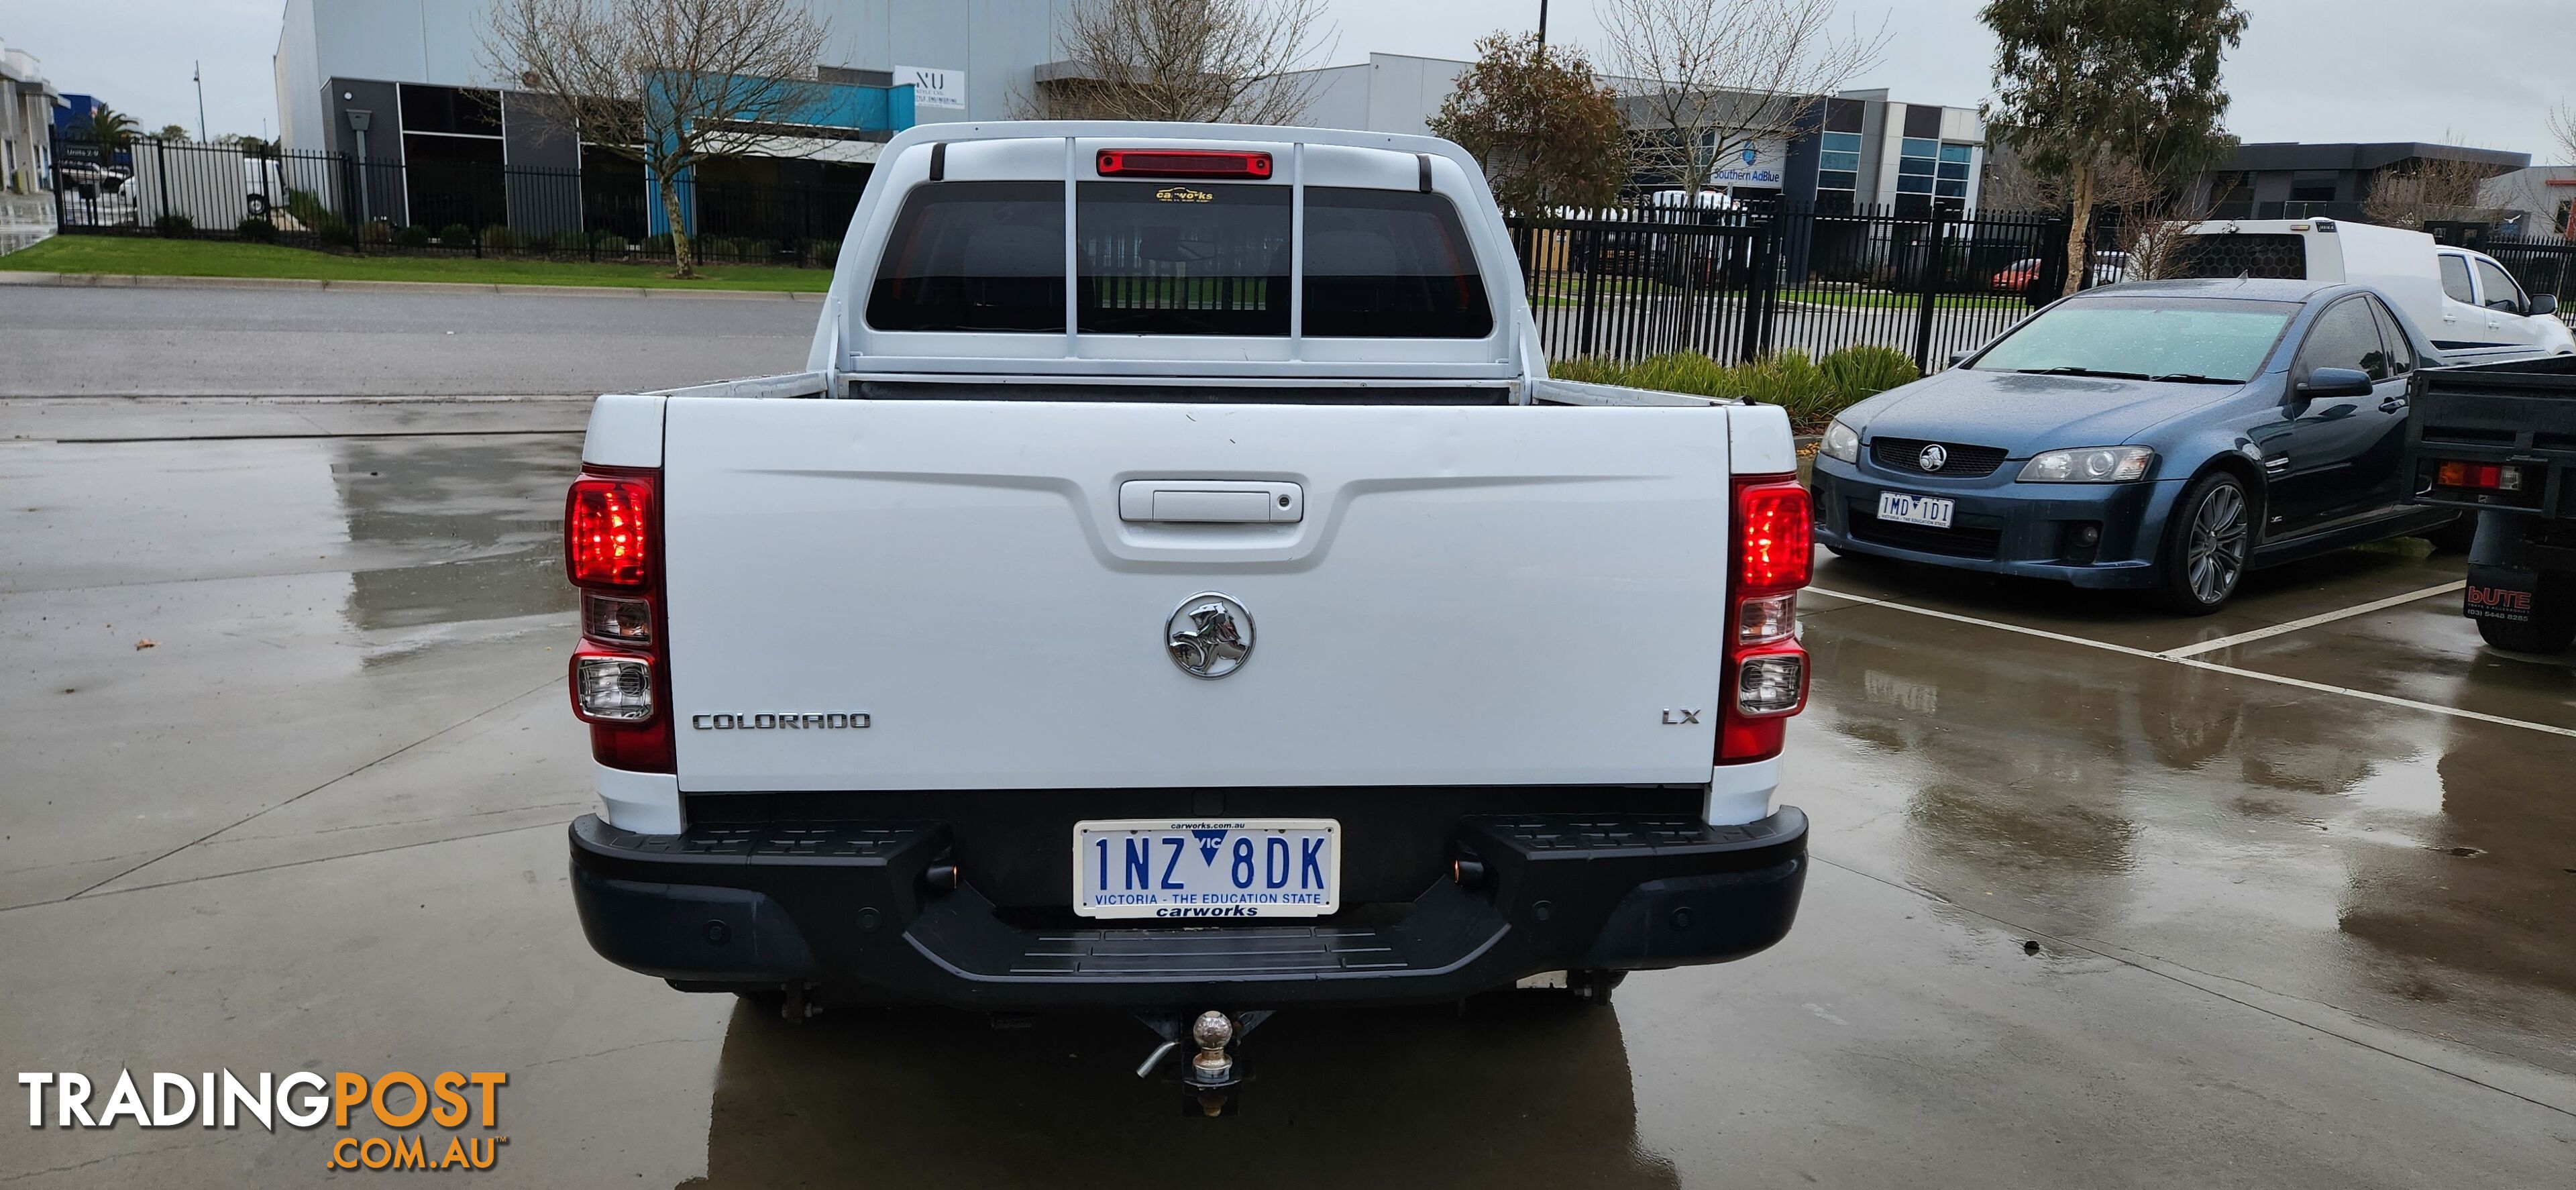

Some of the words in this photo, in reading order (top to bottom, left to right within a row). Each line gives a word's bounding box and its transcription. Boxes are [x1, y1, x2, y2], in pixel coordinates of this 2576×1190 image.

[1714, 170, 1751, 180] Southern
[1752, 169, 1780, 182] AdBlue
[1884, 497, 1909, 516] 1MD
[2468, 586, 2532, 609] bUTE
[692, 712, 871, 730] COLORADO
[1662, 708, 1701, 724] LX
[1194, 838, 1222, 849] VIC
[1096, 837, 1185, 890] 1NZ
[1232, 836, 1325, 889] 8DK
[1095, 894, 1158, 905] VICTORIA
[1172, 894, 1197, 904] THE
[1203, 894, 1277, 904] EDUCATION
[1283, 894, 1321, 904] STATE
[1156, 905, 1258, 917] carworks
